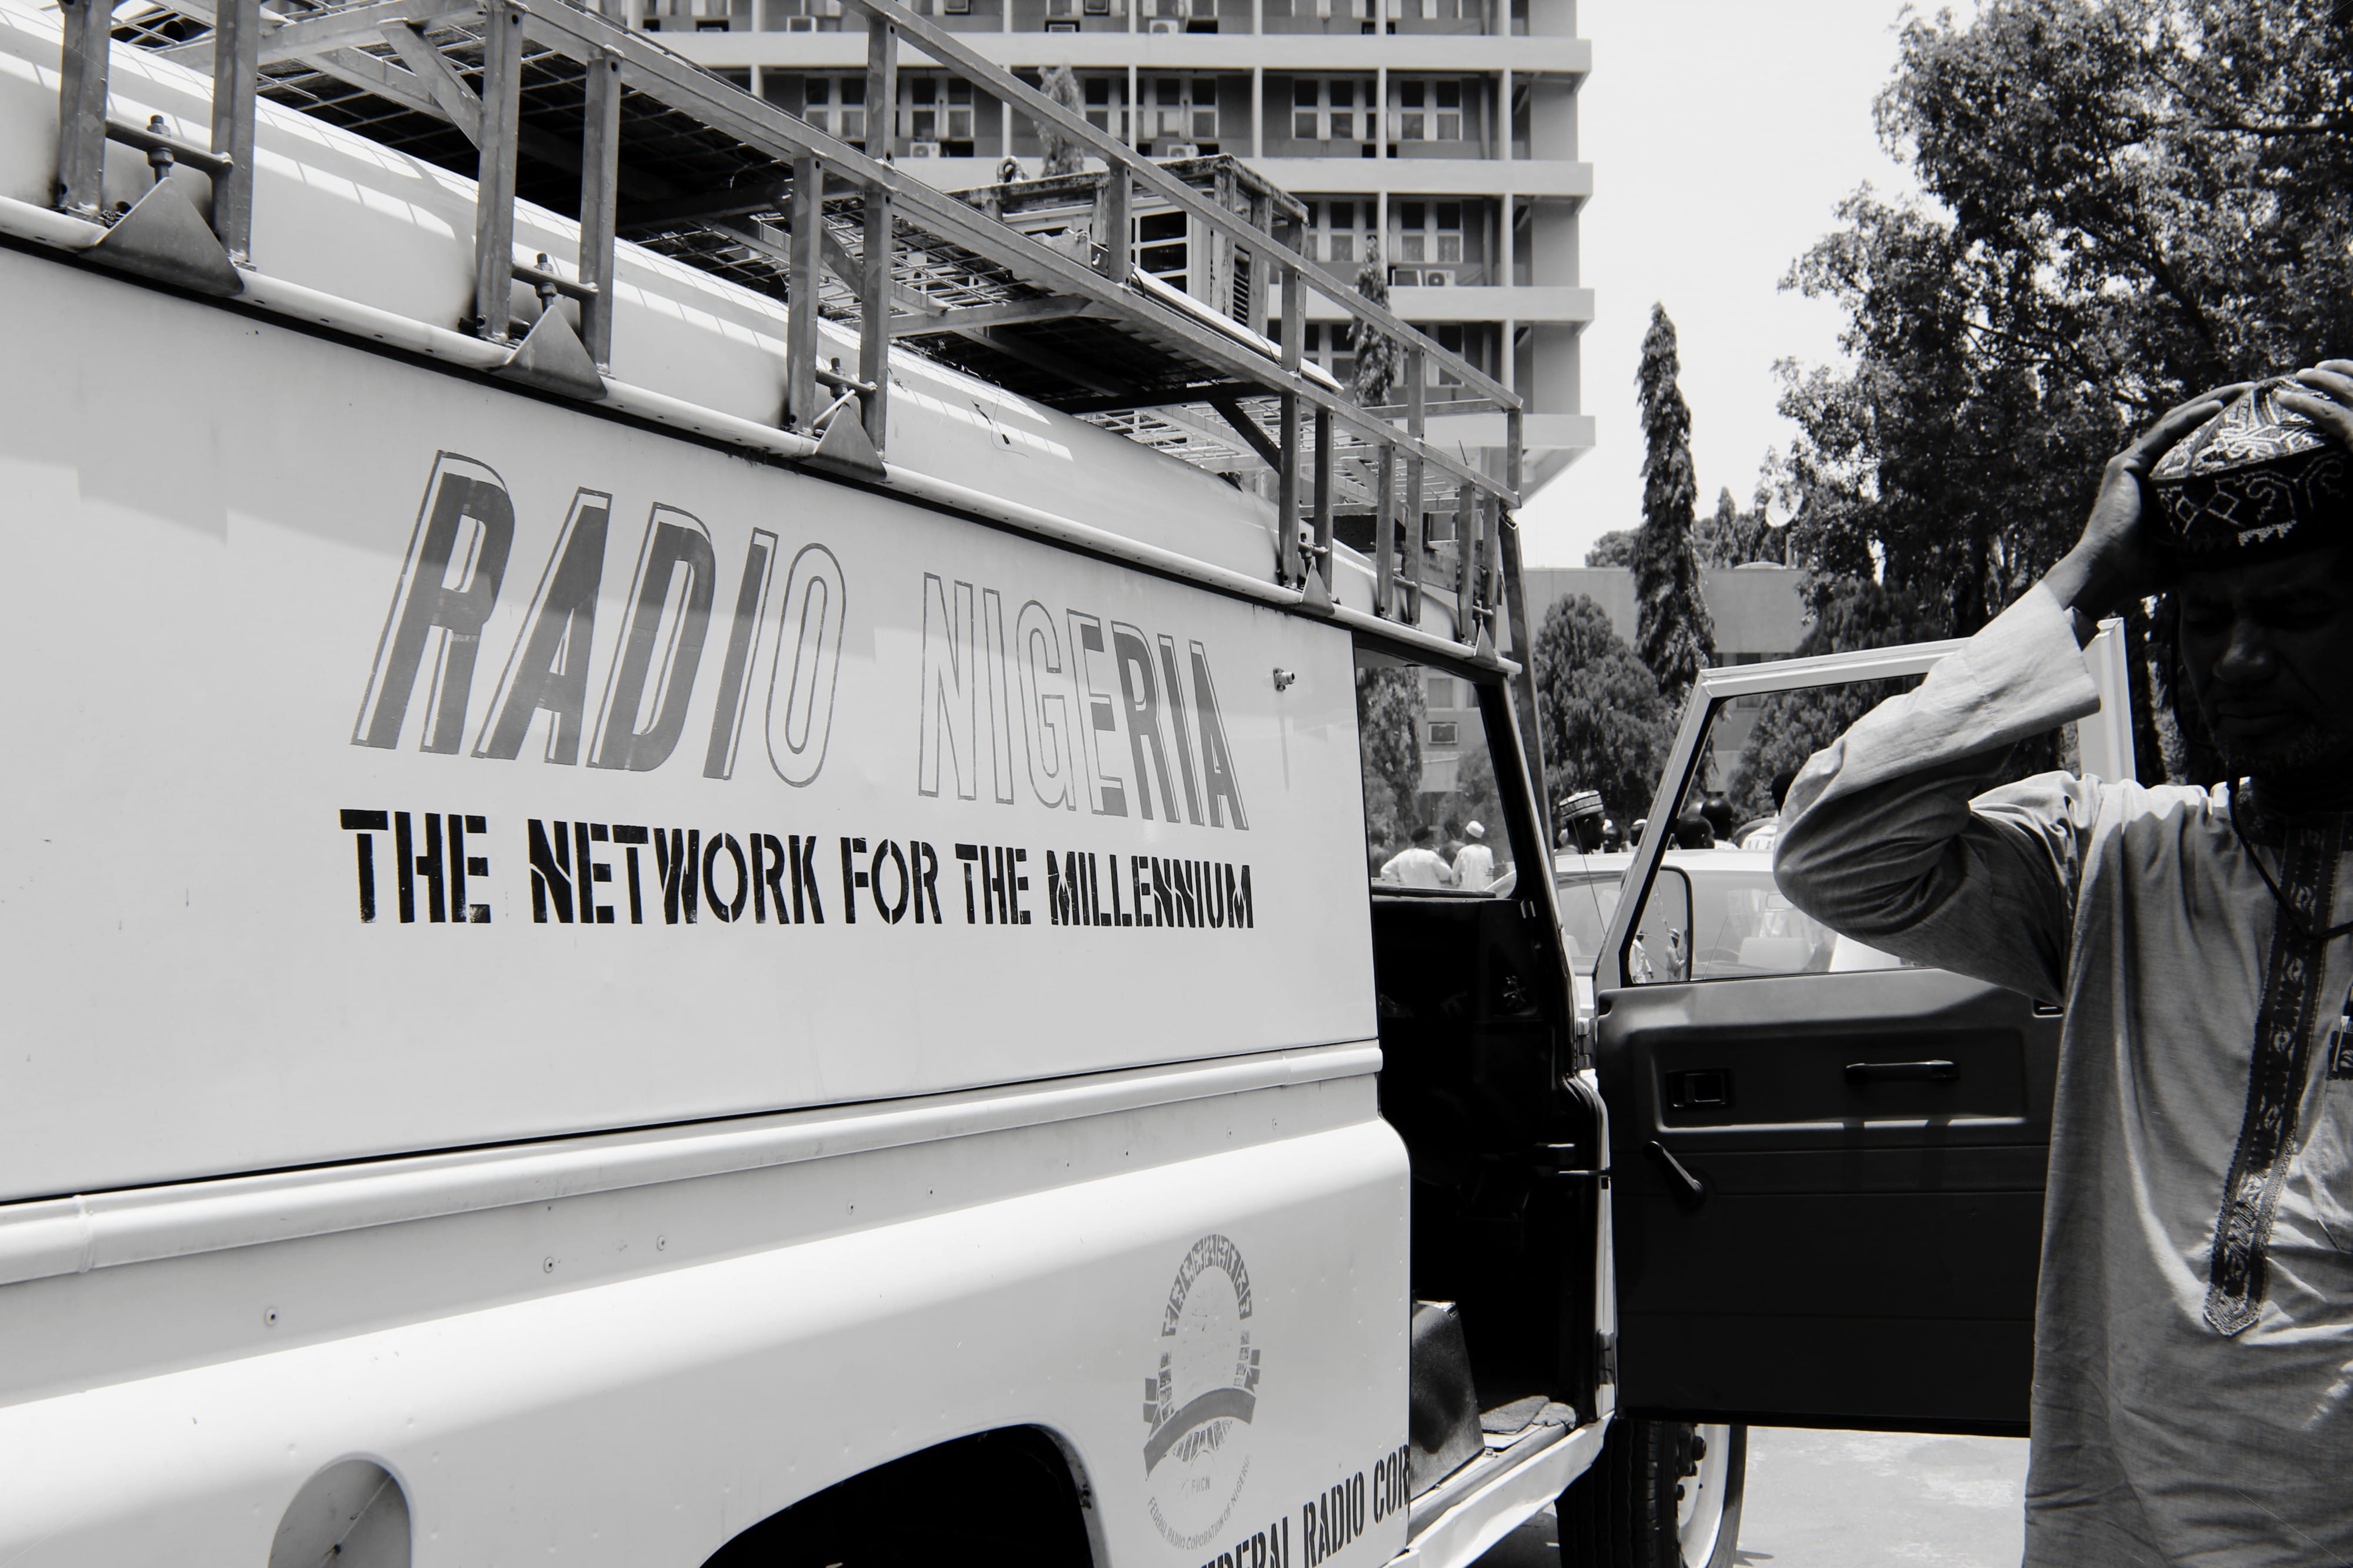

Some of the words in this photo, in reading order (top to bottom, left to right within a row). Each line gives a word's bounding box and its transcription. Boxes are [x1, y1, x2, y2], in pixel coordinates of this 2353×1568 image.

[350, 449, 846, 788] RADIO
[918, 572, 1249, 830] NIGERIA
[339, 809, 491, 924] THE
[527, 818, 825, 925] NETWORK
[840, 837, 942, 926] FOR
[955, 843, 1032, 925] THE
[1046, 849, 1254, 929] MILLENNIUM
[1148, 1496, 1168, 1538] FEDERAL
[1166, 1526, 1185, 1550] RADIO
[1224, 1502, 1231, 1522] OF
[1303, 1472, 1365, 1568] RADIO
